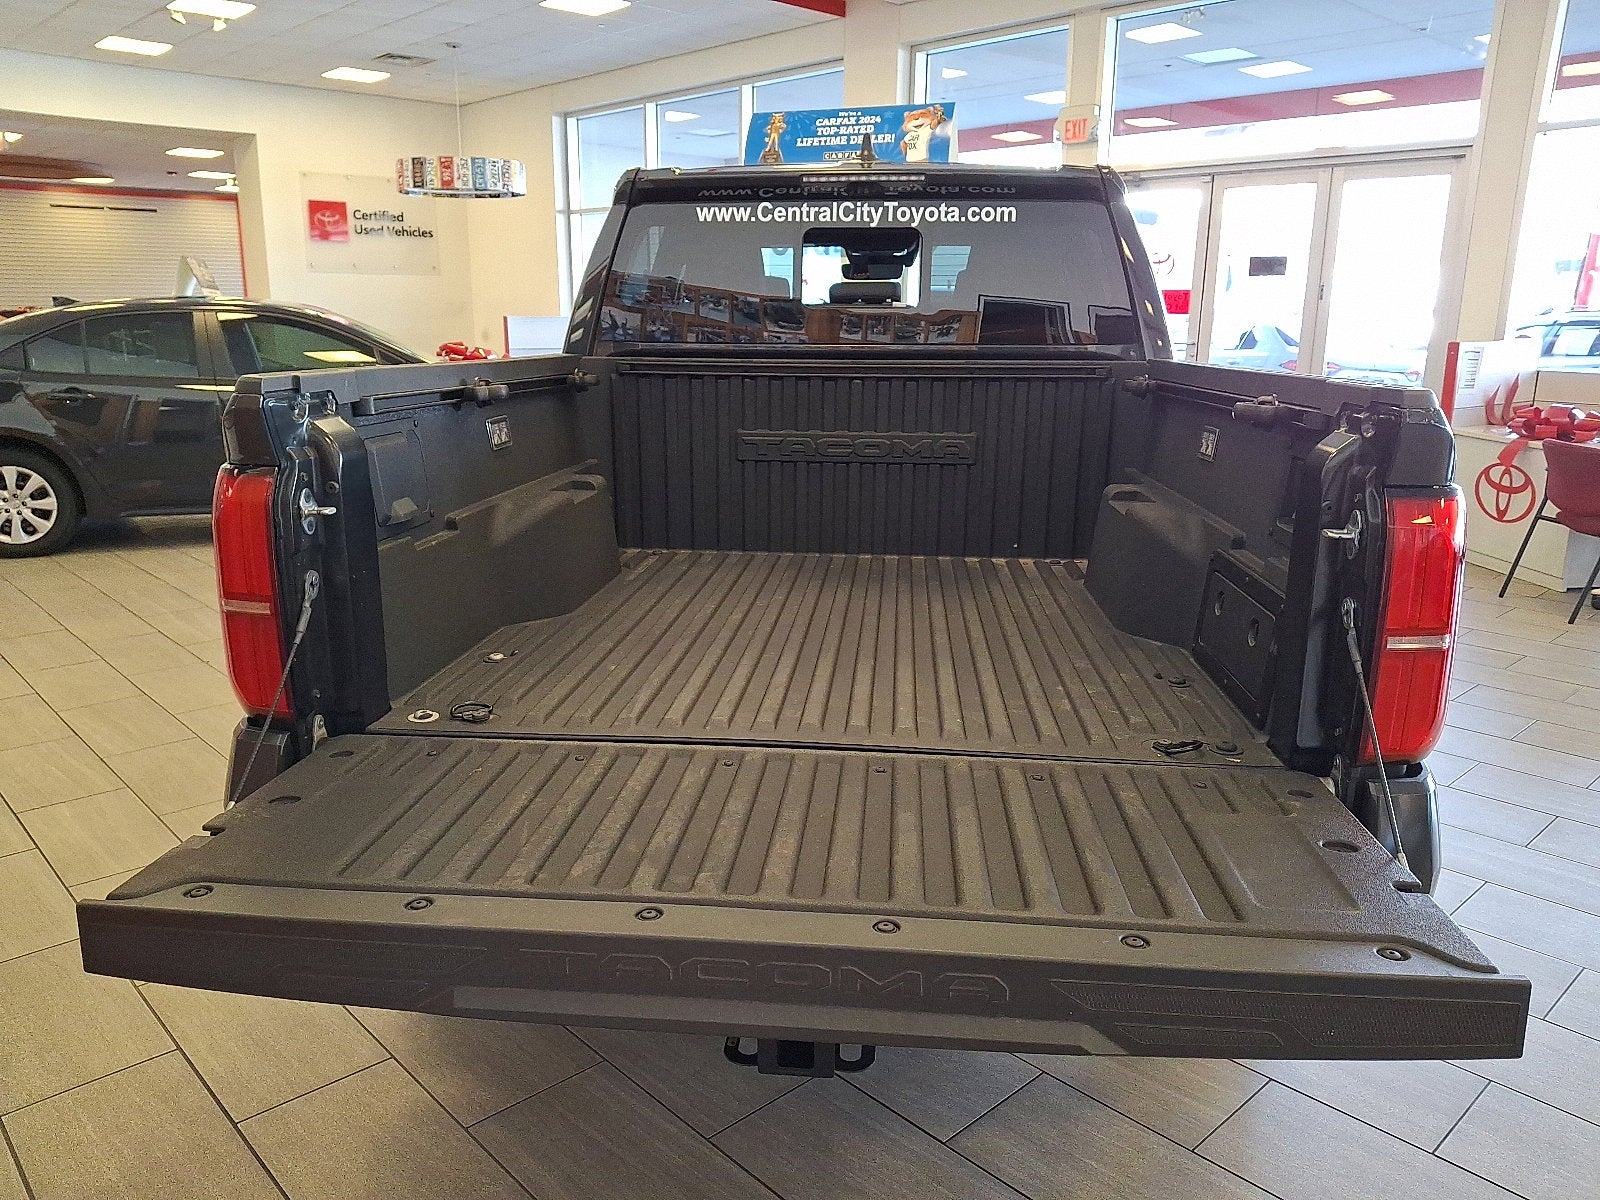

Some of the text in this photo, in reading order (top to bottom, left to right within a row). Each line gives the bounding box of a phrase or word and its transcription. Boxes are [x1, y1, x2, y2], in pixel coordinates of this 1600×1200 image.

[816, 115, 882, 126] CARFAX 2024
[817, 125, 875, 135] TOP-RATED
[1065, 118, 1088, 140] EXIT
[796, 133, 896, 147] LIFETIME DELER!
[824, 151, 862, 160] CARFA
[353, 209, 404, 222] Certified
[696, 201, 1017, 228] www.CentralCityToyota.com
[354, 224, 434, 238] Used Vehicles
[741, 437, 970, 459] TACOMA
[519, 948, 1008, 1001] TACOMA
